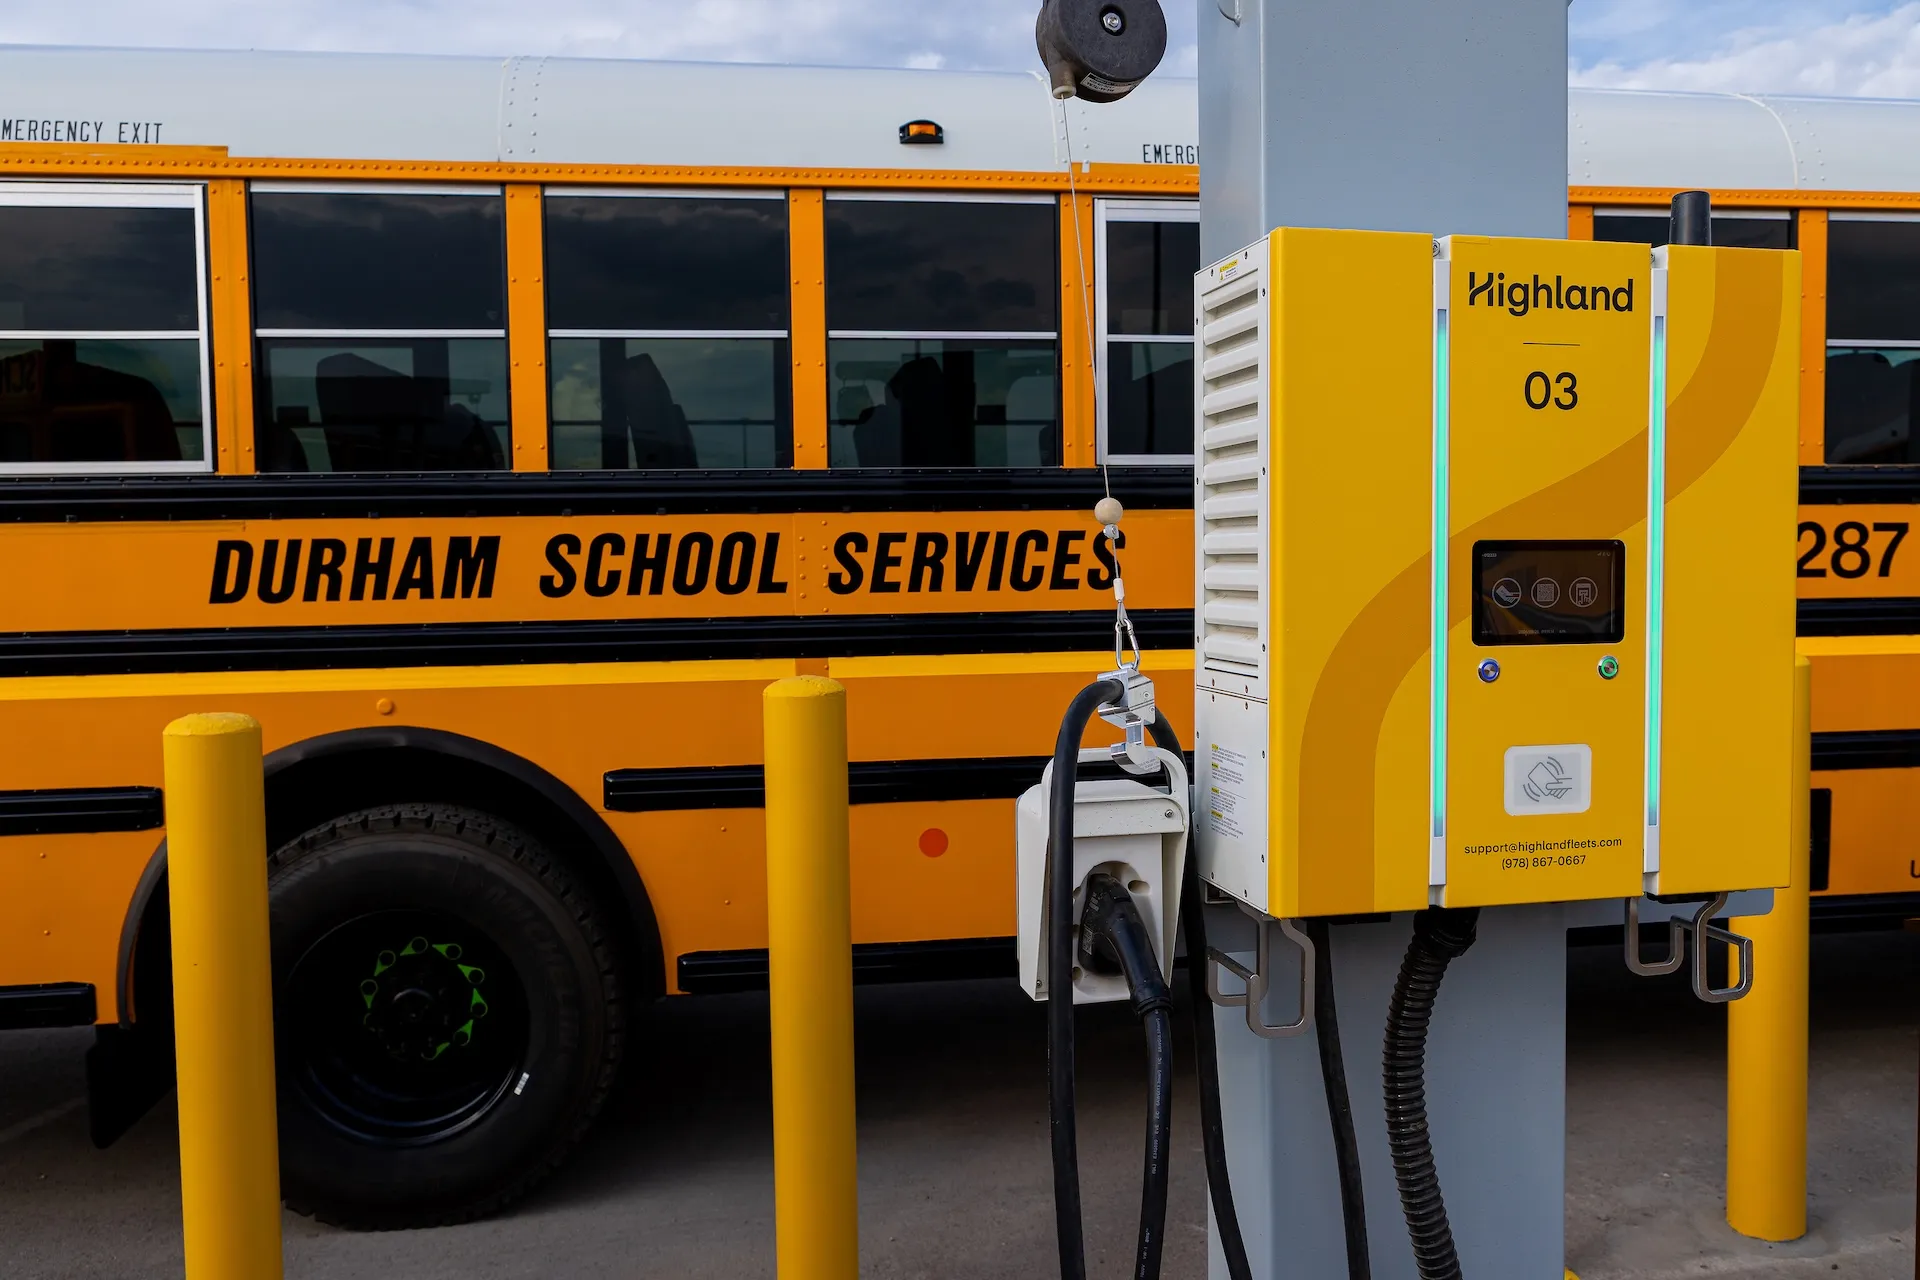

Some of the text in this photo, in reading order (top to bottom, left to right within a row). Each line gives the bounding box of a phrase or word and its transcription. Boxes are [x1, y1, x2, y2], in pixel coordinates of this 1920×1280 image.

[1, 119, 163, 144] MERGENCY EXIT
[1468, 271, 1634, 317] Highland
[1524, 370, 1578, 410] 03
[209, 529, 1126, 604] DURHAM SCHOOL SERVICES
[1797, 521, 1909, 579] 287
[1464, 838, 1622, 855] support@highlandfleets.com
[1501, 855, 1586, 870] (978) 867-0667
